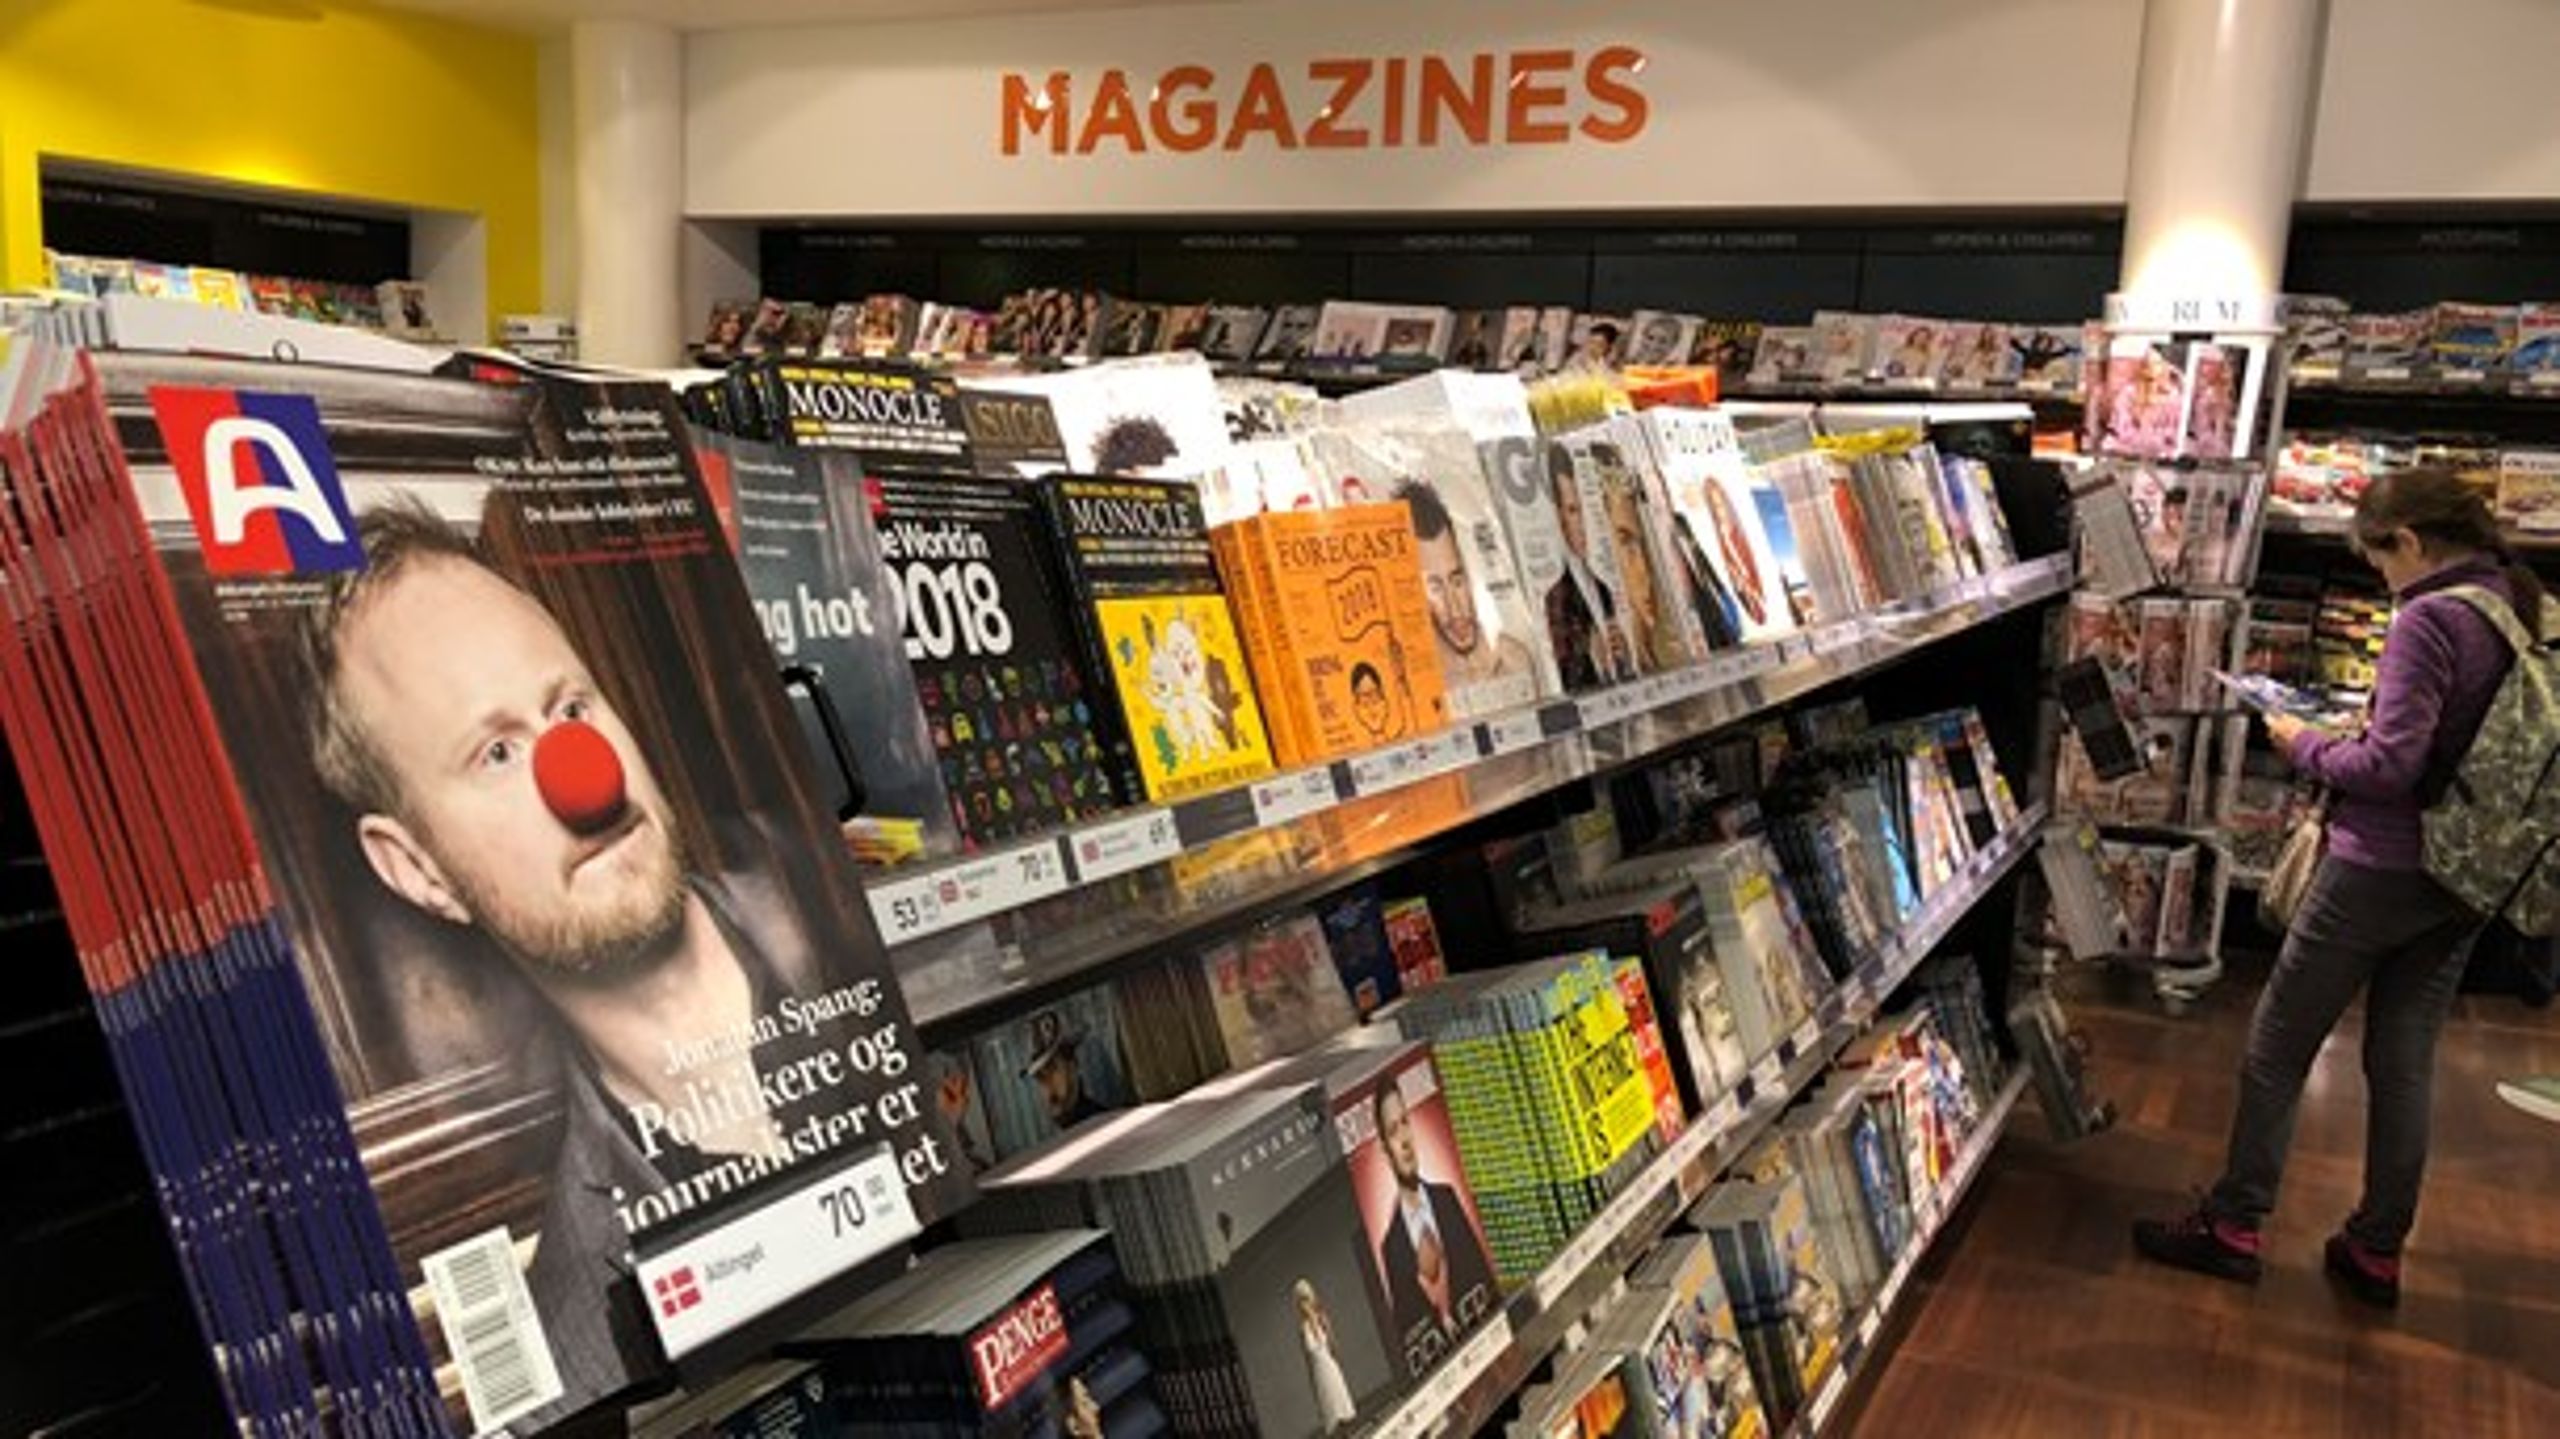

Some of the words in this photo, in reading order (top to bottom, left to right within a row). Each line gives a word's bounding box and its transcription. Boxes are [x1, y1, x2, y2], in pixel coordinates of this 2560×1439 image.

[1000, 45, 1650, 156] MAGAZINES
[787, 384, 946, 427] MONOCLE
[203, 416, 348, 544] A
[893, 519, 966, 559] World
[1068, 498, 1193, 538] MONOCLE
[1275, 528, 1410, 570] FORECAST
[797, 582, 875, 639] hot
[893, 896, 920, 931] 53
[629, 1046, 845, 1160] Politikere
[848, 1020, 908, 1077] og
[611, 1100, 869, 1235] journalister
[877, 1082, 922, 1128] er
[818, 1185, 867, 1239] 70
[972, 1286, 1064, 1407] PENGE
